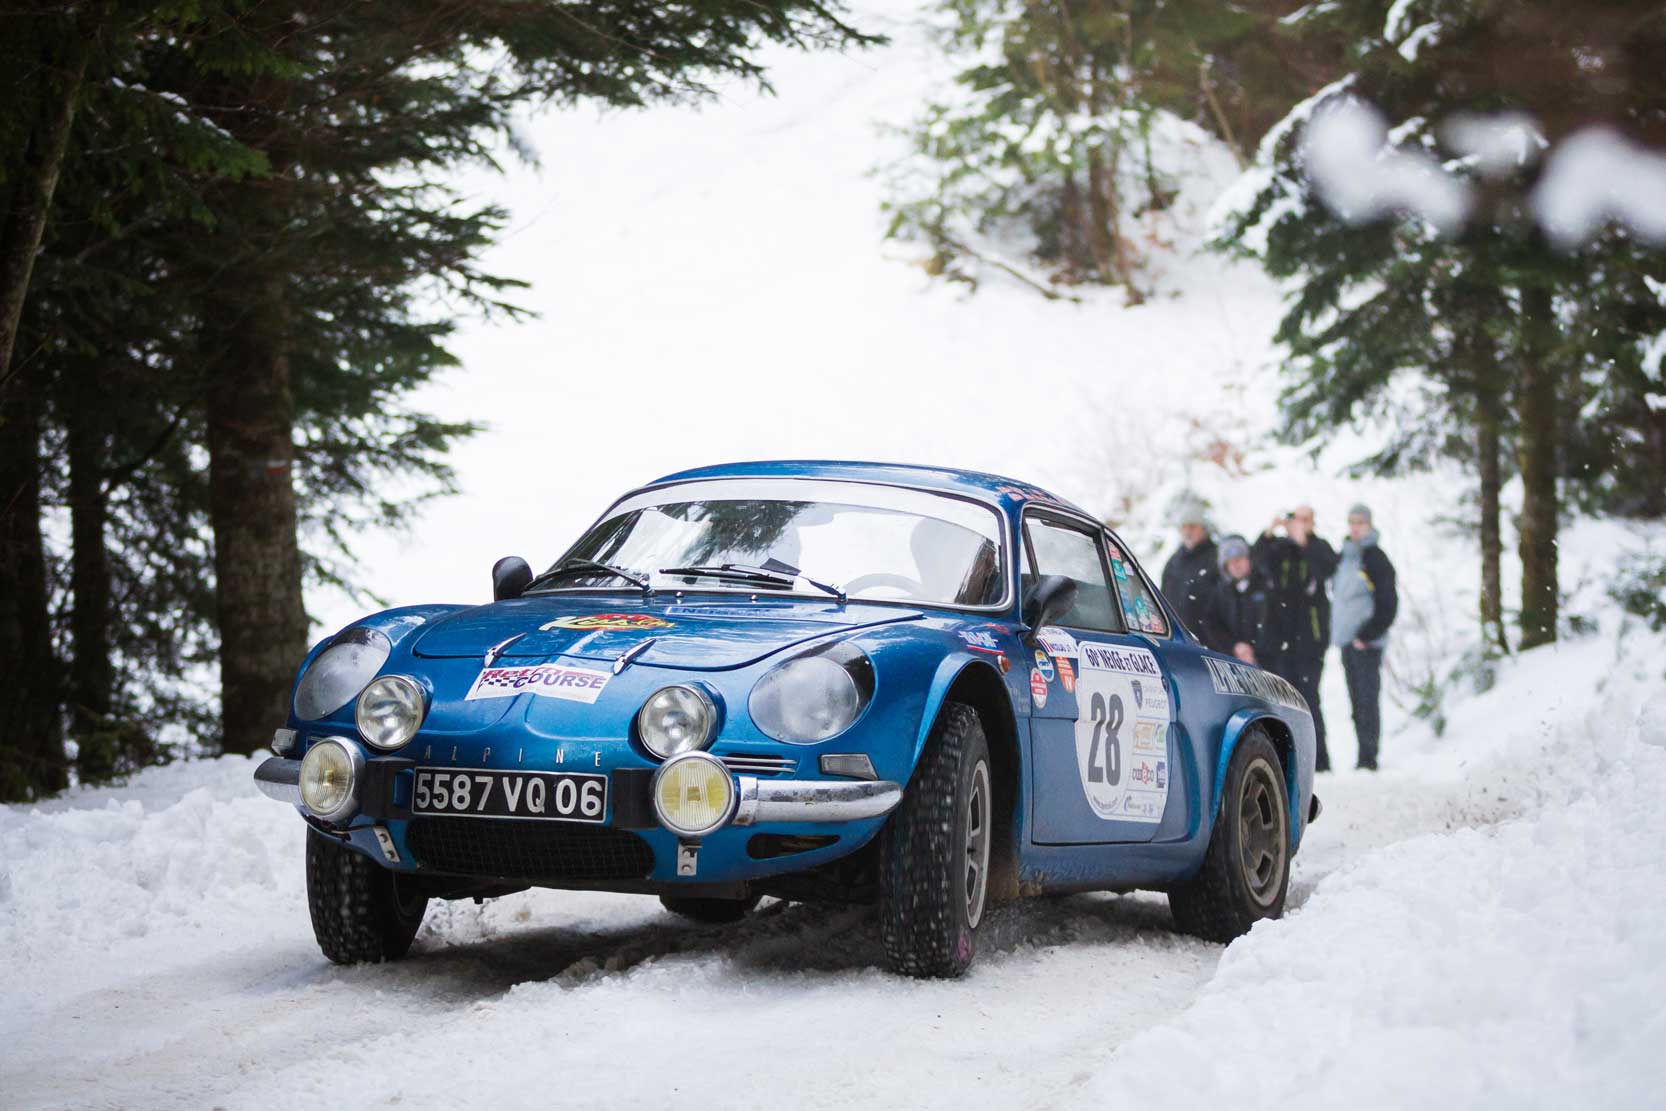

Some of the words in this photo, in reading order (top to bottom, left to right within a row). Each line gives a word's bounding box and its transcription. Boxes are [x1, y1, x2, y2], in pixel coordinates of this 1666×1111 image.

[1097, 649, 1126, 670] NEIGE
[1128, 652, 1156, 674] GLACE
[513, 672, 607, 689] COURSE
[1087, 691, 1124, 786] 28
[424, 744, 602, 767] ALPINE
[416, 773, 494, 811] 5587
[502, 776, 546, 814] VQ
[555, 778, 602, 817] 06
